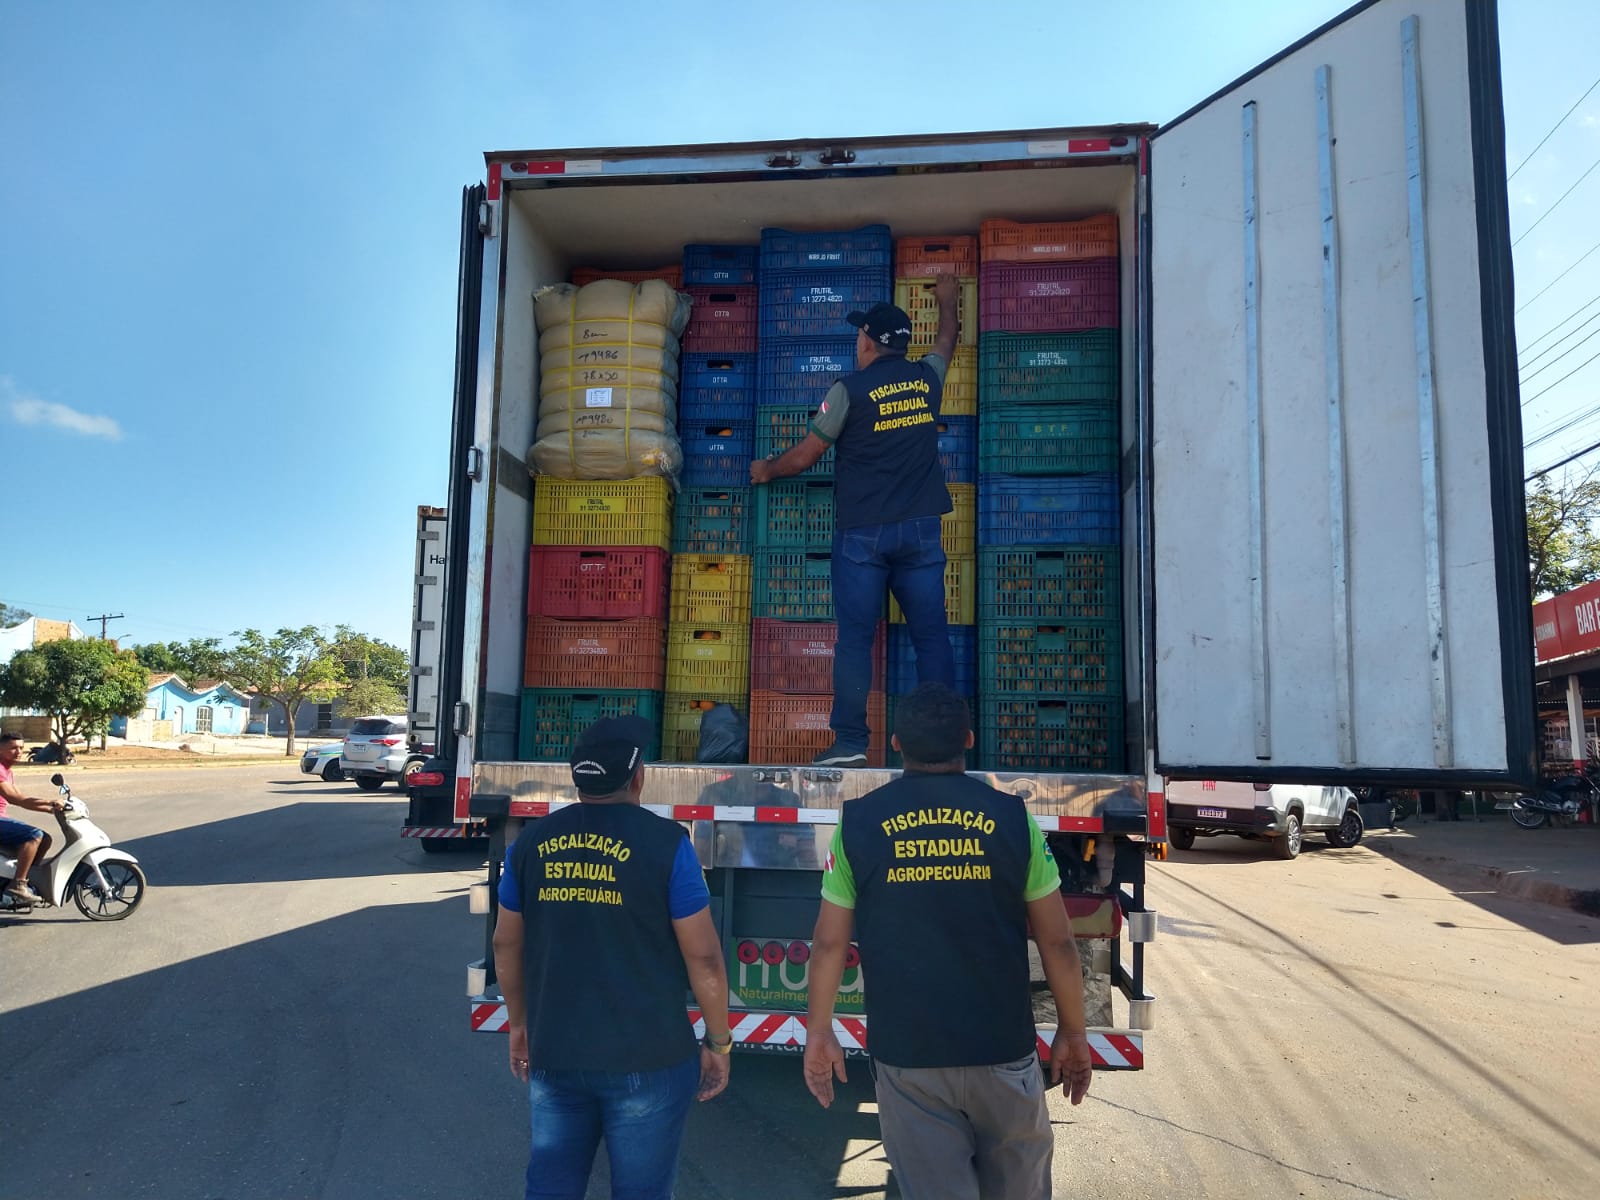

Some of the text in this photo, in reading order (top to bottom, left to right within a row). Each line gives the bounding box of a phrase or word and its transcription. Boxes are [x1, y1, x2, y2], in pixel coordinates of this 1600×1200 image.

[810, 287, 833, 295] FRUTAL
[712, 376, 728, 384] OTTA
[869, 379, 929, 402] FISCALIZAÇÃO
[879, 397, 928, 415] ESTADUAL
[874, 412, 934, 431] AGROPECUÁRIA
[1575, 601, 1596, 635] BAR
[577, 638, 600, 647] FRUTAL
[881, 808, 996, 837] FISCALIZAÇÃO
[537, 833, 631, 862] FISCALIZAÇÃO
[894, 838, 985, 859] ESTADUAL
[886, 862, 992, 883] AGROPECUÁRIA
[538, 887, 623, 906] AGROPECUÁRIA
